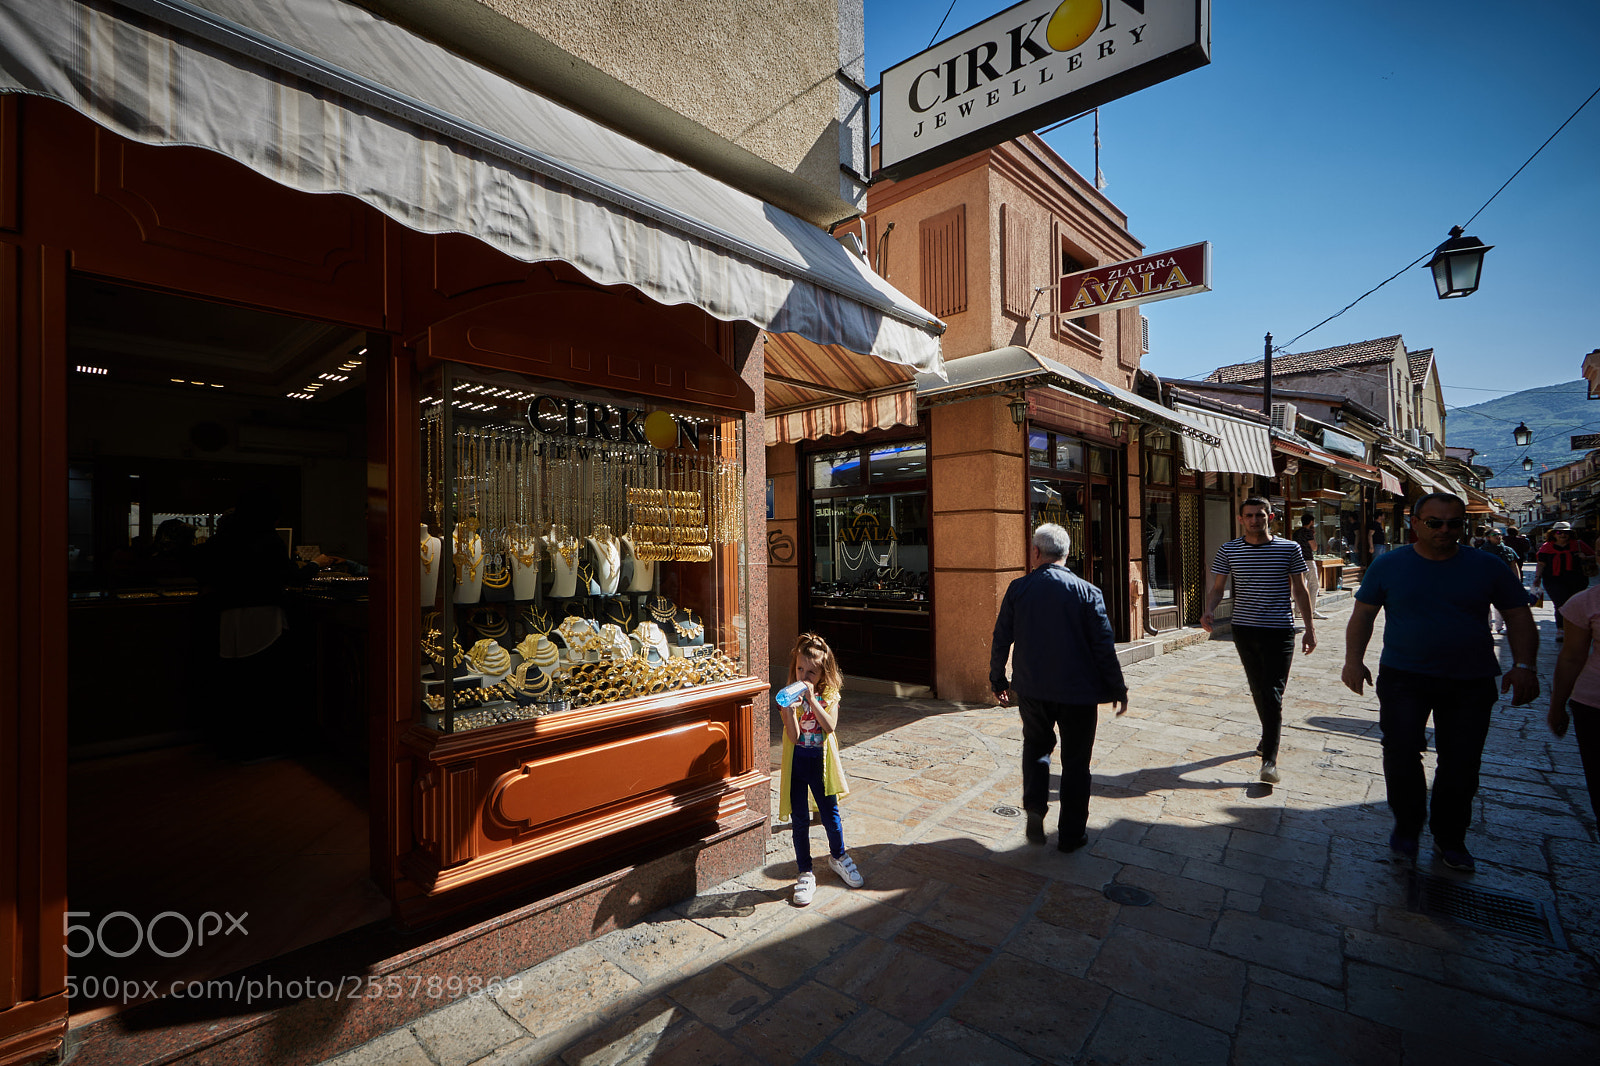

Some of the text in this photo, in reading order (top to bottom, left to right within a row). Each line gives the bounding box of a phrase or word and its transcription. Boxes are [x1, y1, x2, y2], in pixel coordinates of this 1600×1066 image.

[913, 24, 1147, 138] JEWELLERY
[1108, 257, 1177, 280] ZLATARA
[1070, 266, 1192, 310] AVALA
[527, 395, 700, 452] CIRKON
[534, 442, 698, 469] JEWELLERY
[836, 526, 899, 542] AVALA
